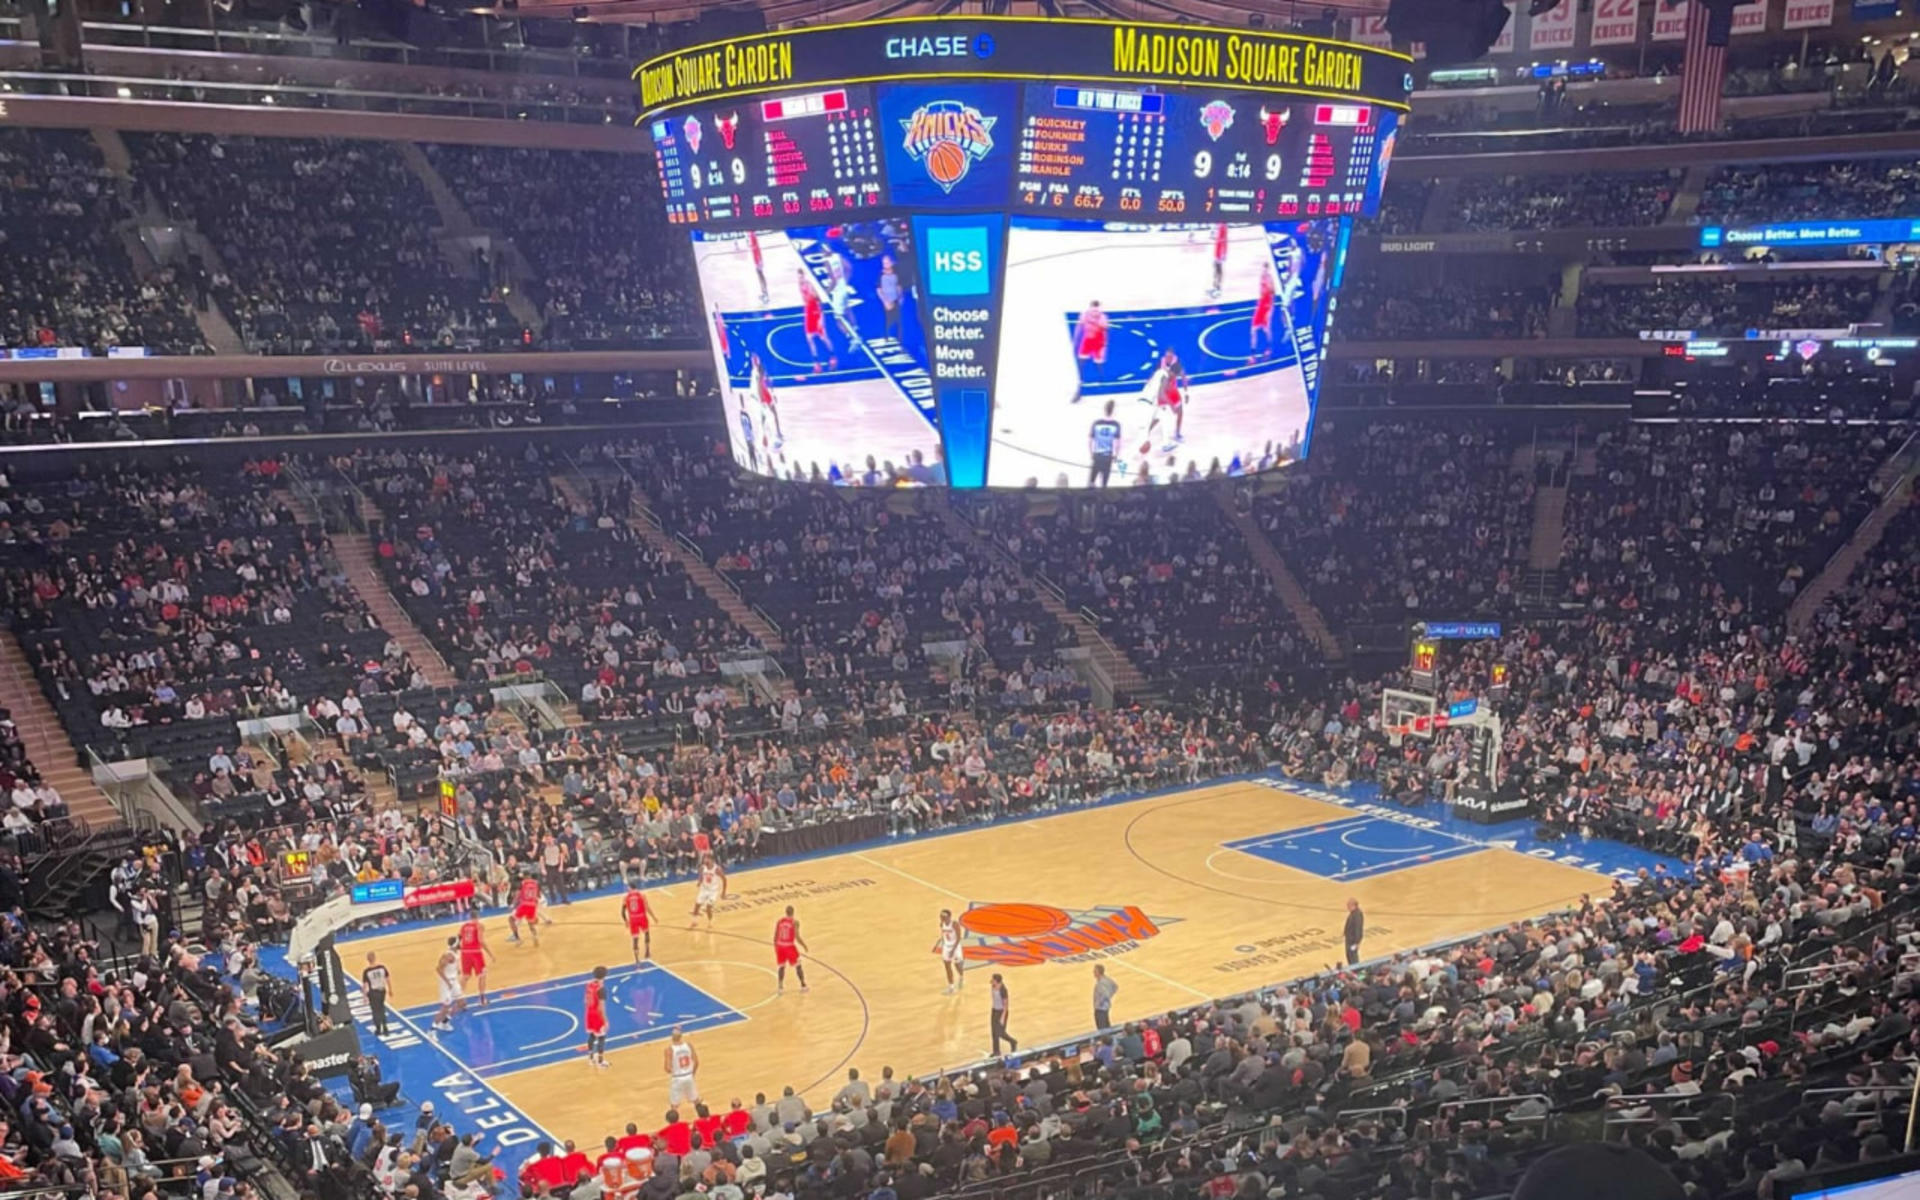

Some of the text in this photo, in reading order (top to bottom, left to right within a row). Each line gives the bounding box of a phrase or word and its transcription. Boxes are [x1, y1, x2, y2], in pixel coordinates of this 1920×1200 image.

[1788, 3, 1830, 22] KNICKS
[1594, 23, 1635, 39] KNICKS
[886, 36, 968, 59] CHASE
[1114, 27, 1362, 91] MADISON SQUARE GARDEN
[675, 52, 722, 97] SQUARE
[725, 41, 792, 87] GARDEN
[906, 107, 988, 147] KNICKS
[1036, 118, 1087, 130] QUICKLEY
[1035, 129, 1086, 142] FOURNIER
[1034, 141, 1068, 152] BURKS
[1032, 153, 1085, 166] ROBINSON
[1194, 150, 1212, 178] 9
[1265, 154, 1281, 180] 9
[690, 163, 701, 189] 9
[731, 157, 745, 185] 9
[1031, 165, 1072, 176] RANDLE
[1024, 191, 1035, 205] 4
[1054, 193, 1063, 206] 6
[1074, 195, 1104, 209] 66.7
[1120, 197, 1142, 210] 0.0
[1158, 199, 1185, 212] 50.0
[1765, 229, 1798, 241] Better.
[1799, 229, 1826, 240] Move
[1827, 226, 1862, 239] Better.
[1381, 241, 1435, 253] BUD LIGHT
[934, 251, 983, 272] HSS
[933, 307, 989, 322] Choose
[934, 325, 984, 340] Better.
[935, 345, 974, 360] Move
[347, 361, 487, 373] LEXUS SUITE LEVEL
[936, 363, 987, 378] Better.
[1465, 627, 1495, 635] ULTRA
[1419, 654, 1432, 670] 14
[1254, 927, 1326, 949] CHASE
[432, 1071, 540, 1147] DELTA
